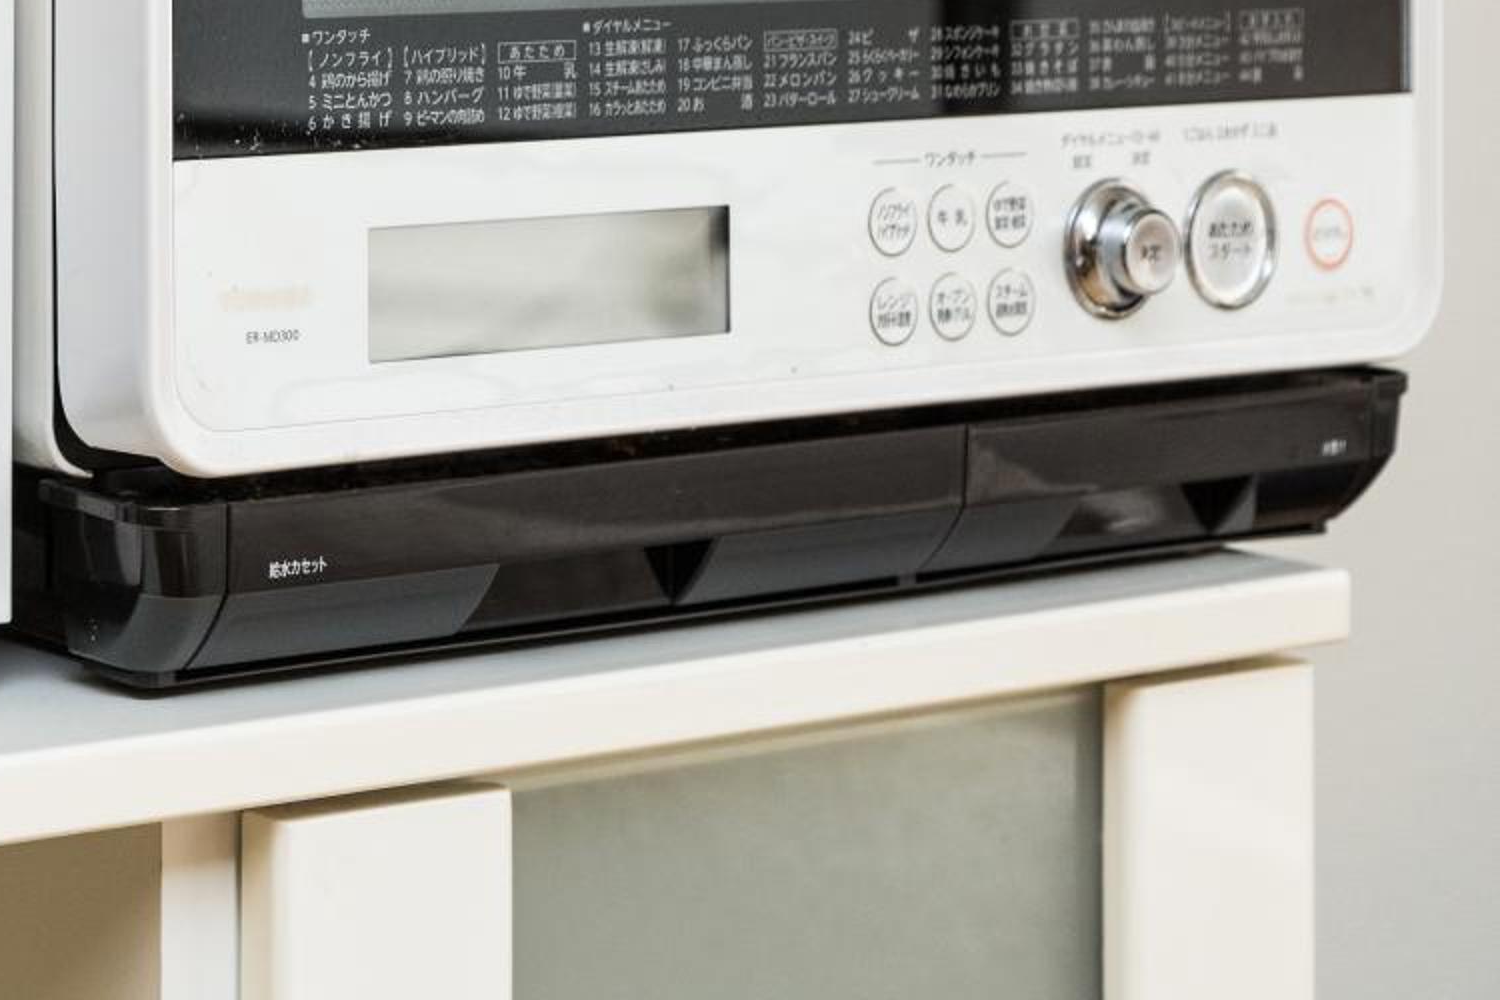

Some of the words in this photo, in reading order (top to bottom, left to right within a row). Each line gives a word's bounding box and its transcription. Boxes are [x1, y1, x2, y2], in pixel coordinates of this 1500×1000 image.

[592, 19, 672, 35] ダイヤルメニュー
[312, 28, 371, 45] ワンタッチ
[509, 44, 566, 60] あたため
[321, 92, 393, 110] ミニとんかつ
[417, 86, 486, 105] ハンバーグ
[924, 151, 975, 168] ワンタッチ
